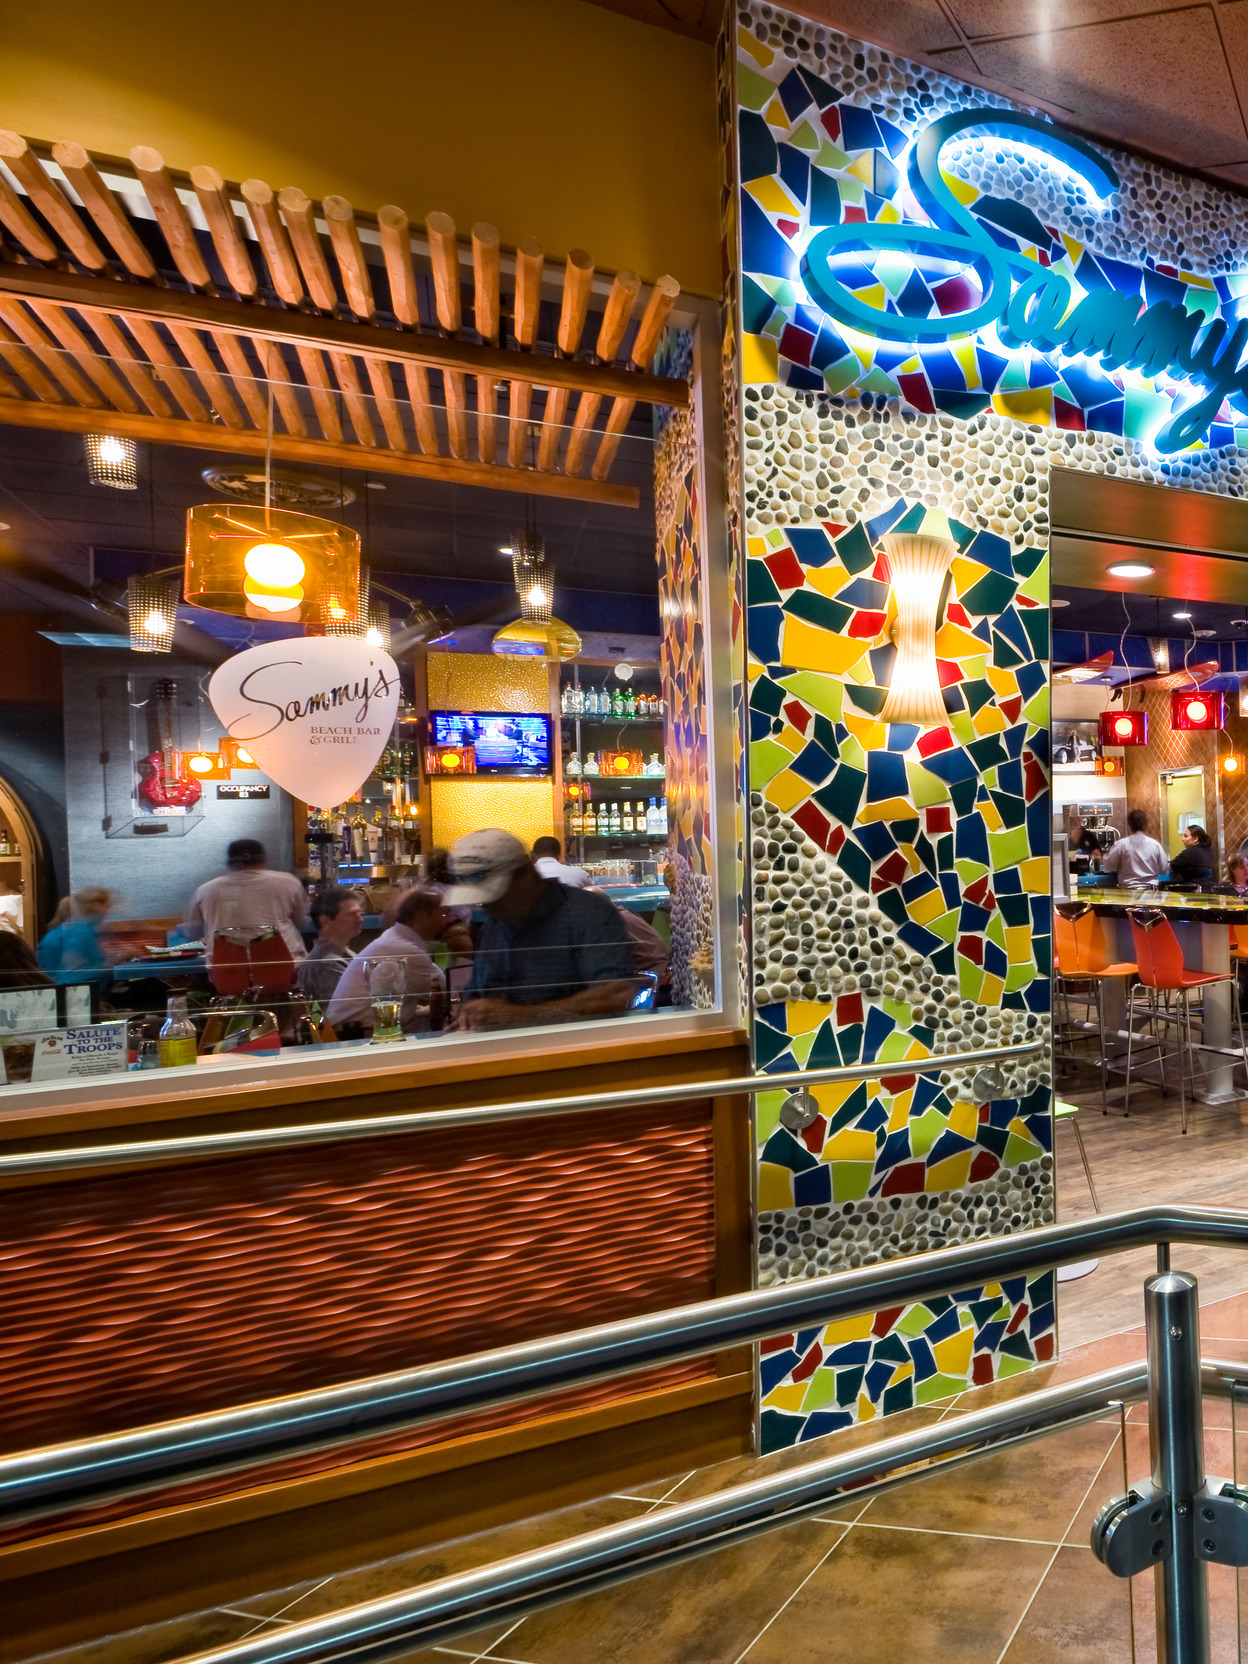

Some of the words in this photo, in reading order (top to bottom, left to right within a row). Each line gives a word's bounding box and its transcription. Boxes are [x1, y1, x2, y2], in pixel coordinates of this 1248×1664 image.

[227, 658, 400, 741] Sammy's
[310, 726, 353, 735] BEACH
[357, 727, 381, 735] BAR
[309, 735, 322, 745] &
[66, 1027, 121, 1039] SALUTE
[64, 1042, 123, 1054] TROOPS
